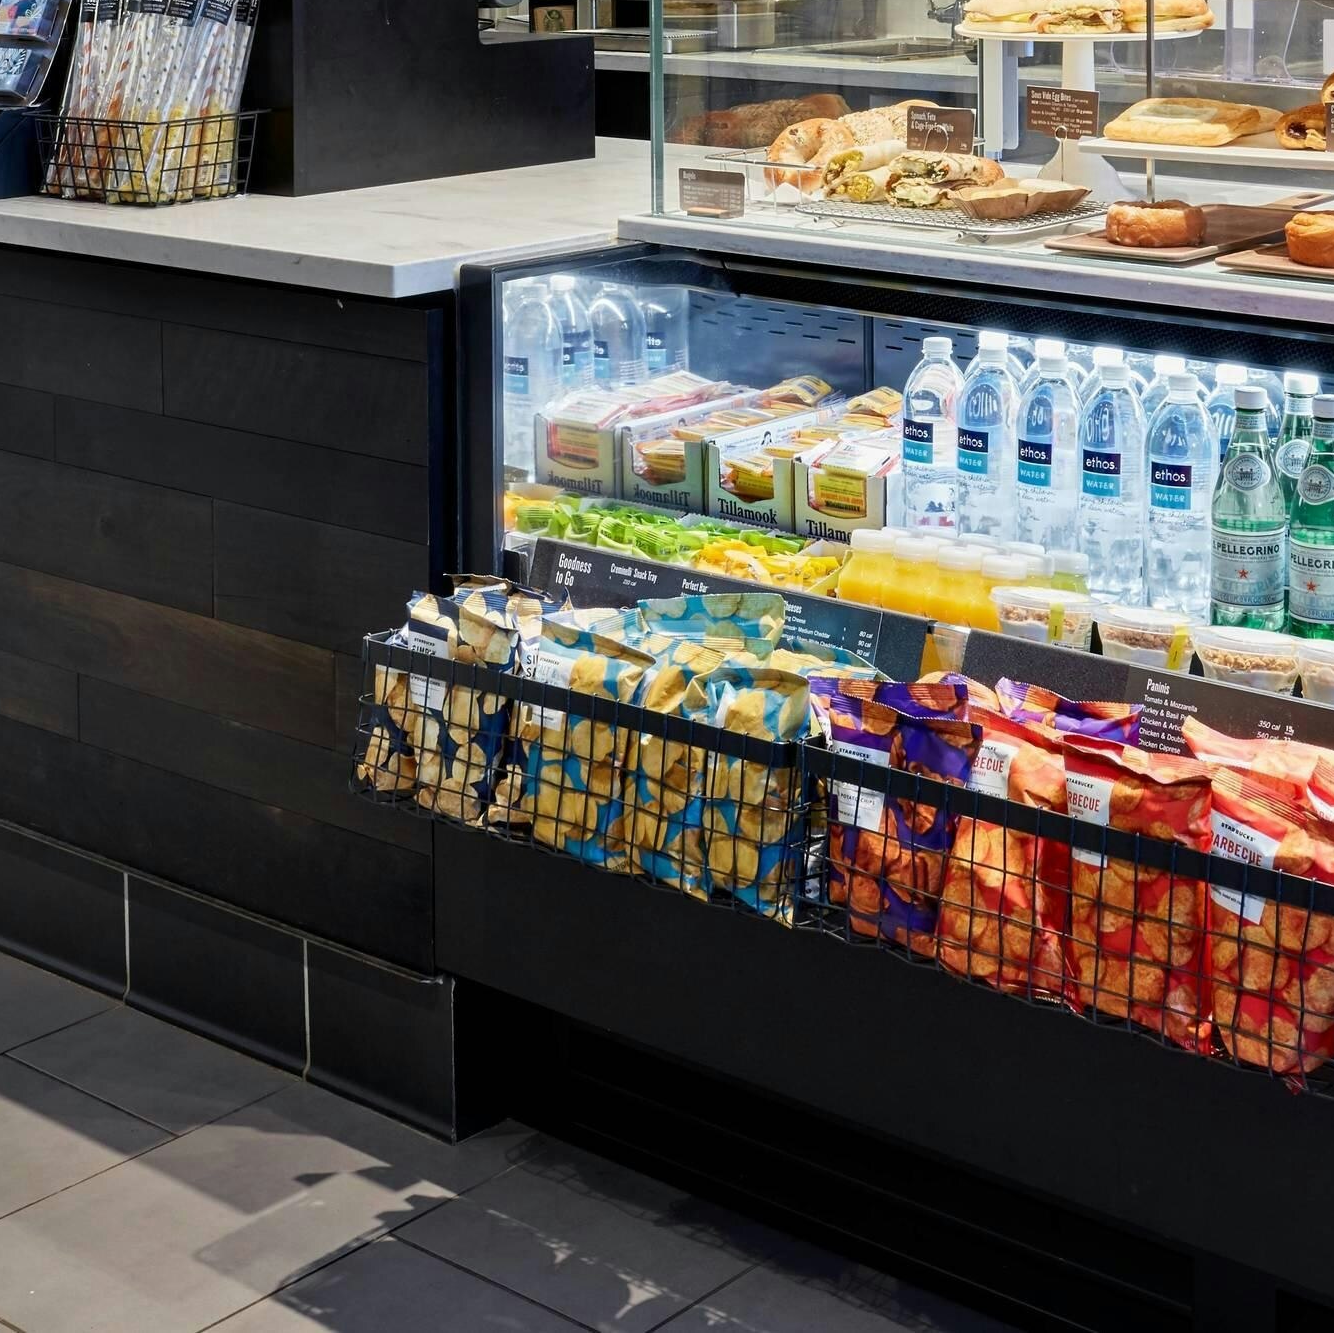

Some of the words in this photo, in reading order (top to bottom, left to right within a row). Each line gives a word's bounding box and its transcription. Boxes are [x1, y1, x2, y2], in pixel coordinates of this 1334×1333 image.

[1020, 469, 1045, 480] WATER
[1085, 478, 1115, 490] WATER
[1155, 492, 1185, 503] WATER
[717, 498, 777, 525] Tillamook
[559, 553, 592, 574] Goodness
[555, 571, 562, 584] to
[565, 571, 574, 586] Go
[1146, 678, 1170, 695] Paninis
